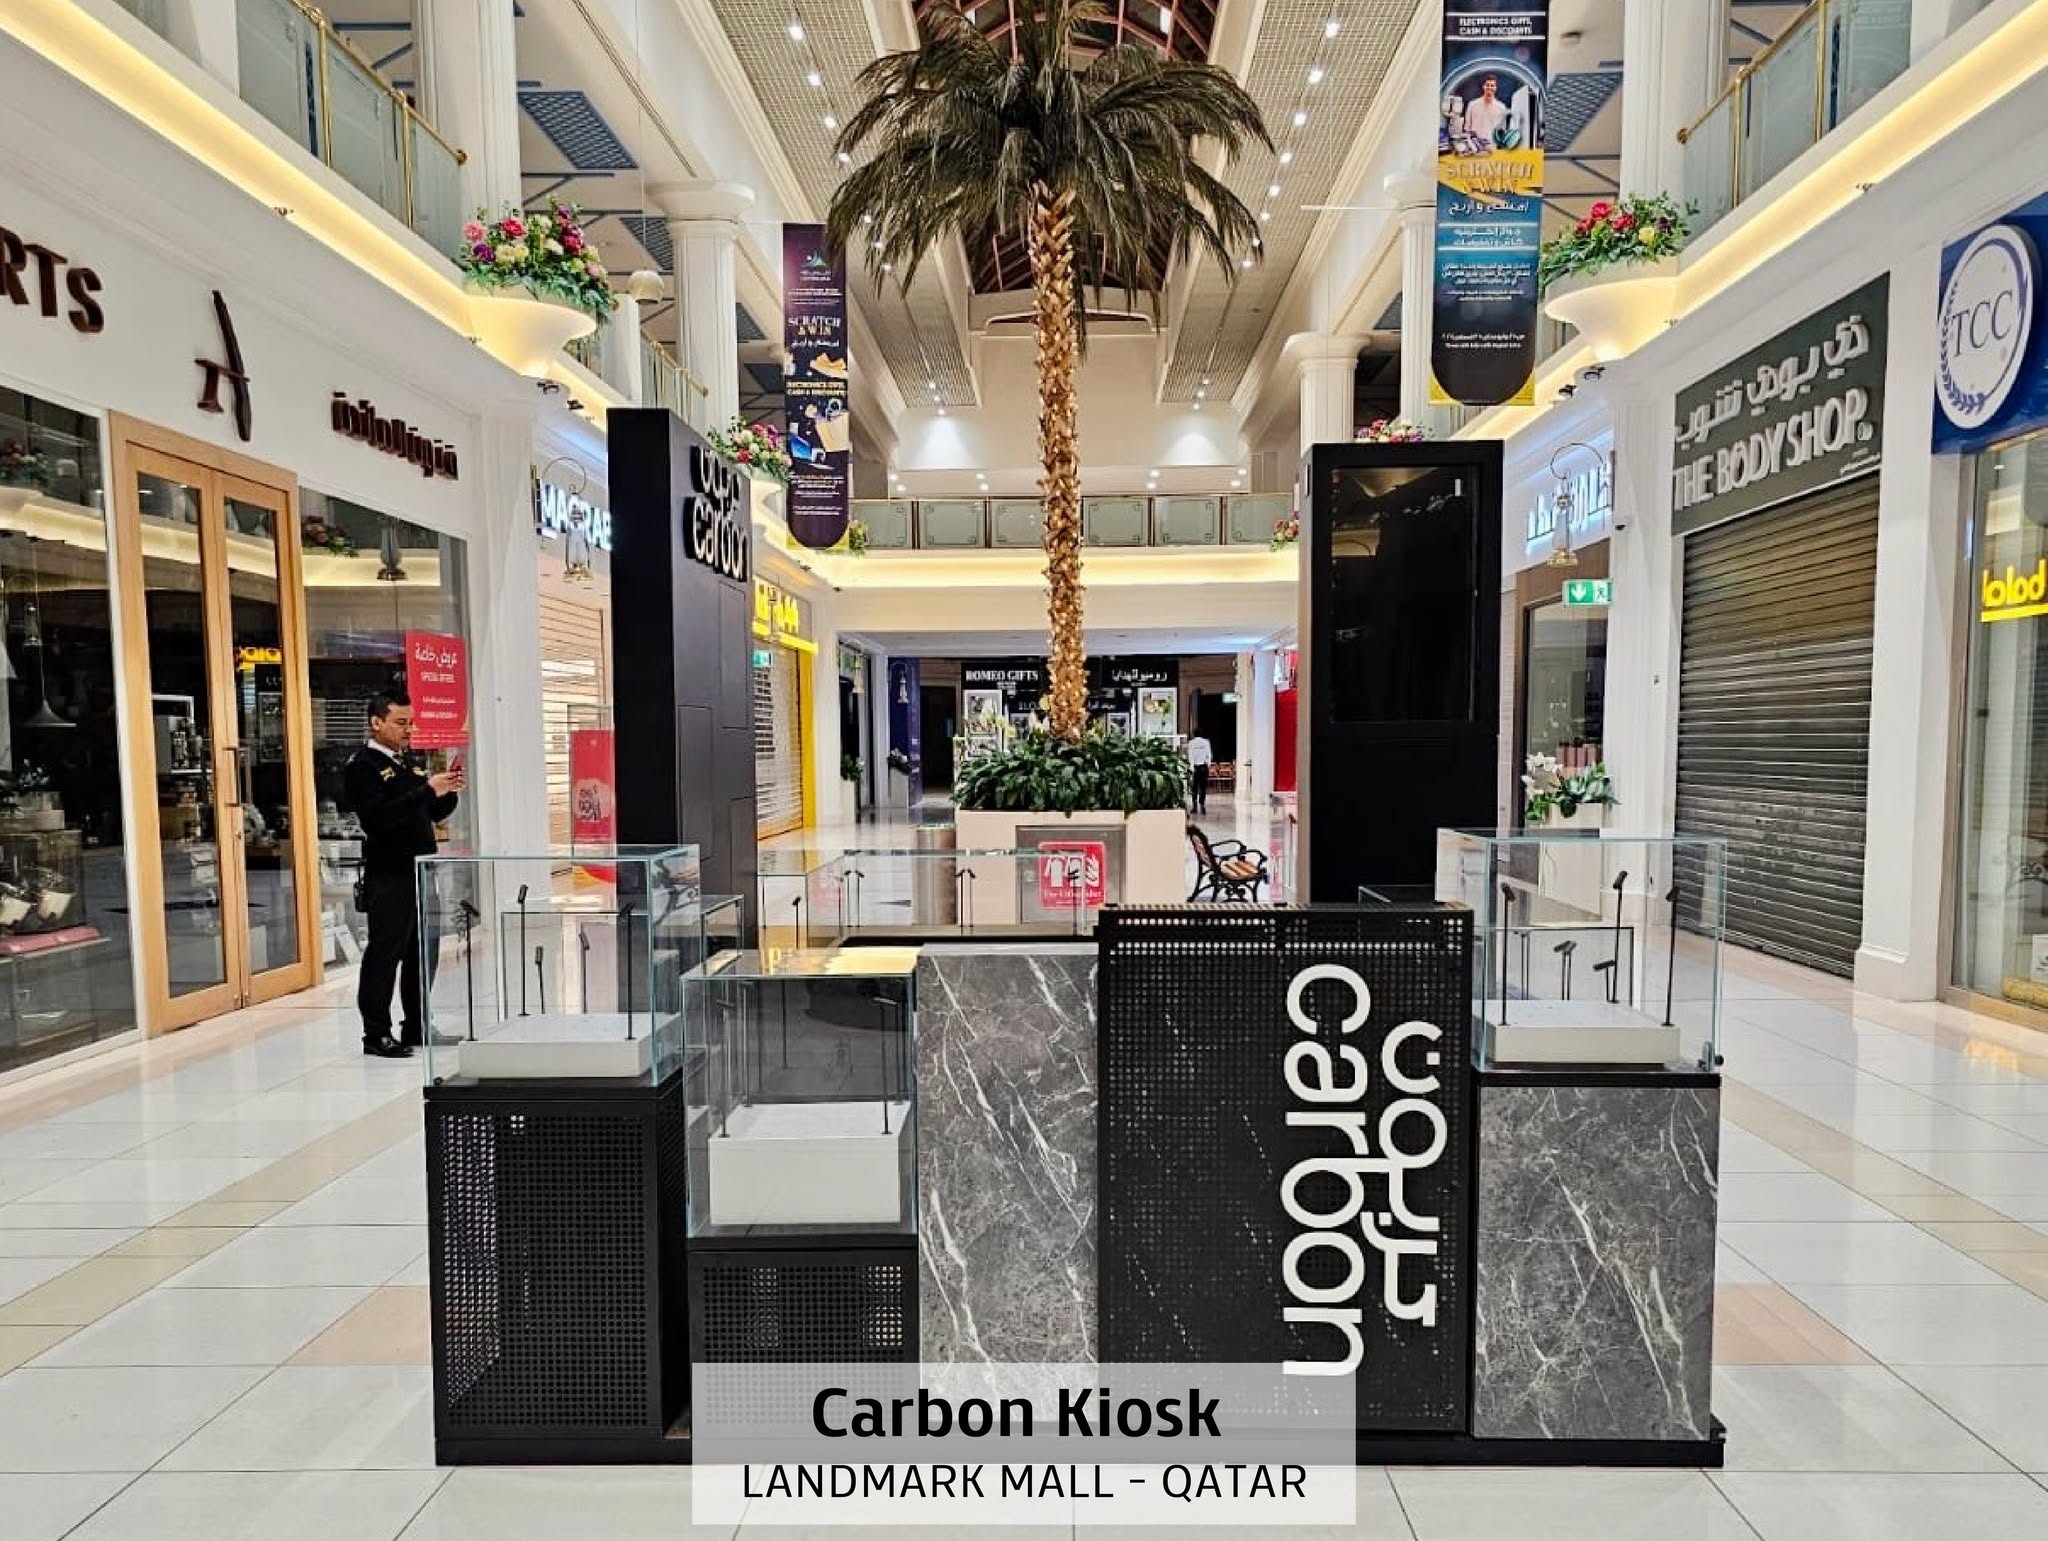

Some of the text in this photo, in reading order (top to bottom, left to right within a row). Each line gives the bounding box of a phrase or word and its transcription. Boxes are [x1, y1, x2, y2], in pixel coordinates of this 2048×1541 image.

[1953, 289, 2013, 358] TCC
[1673, 455, 1714, 511] THE
[1716, 422, 1788, 495] BODY
[965, 669, 1038, 681] ROMEO GIFTS
[1280, 963, 1371, 1376] carbon
